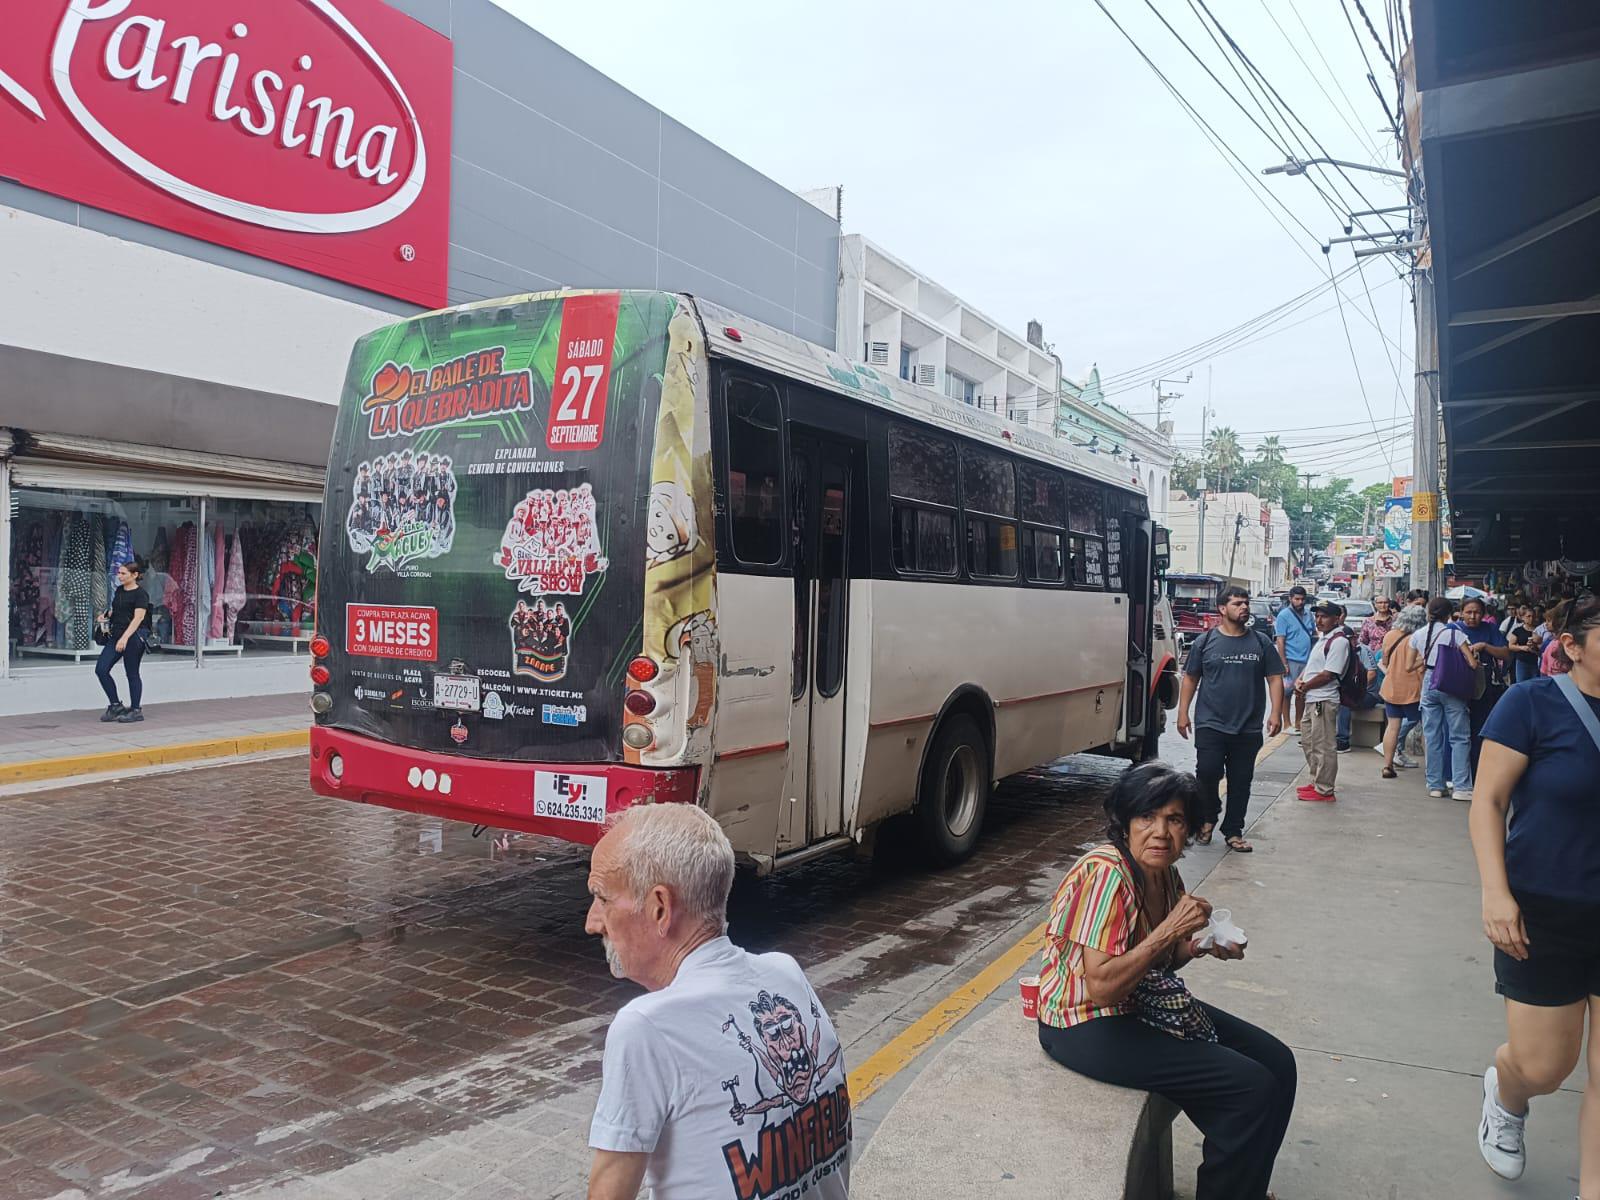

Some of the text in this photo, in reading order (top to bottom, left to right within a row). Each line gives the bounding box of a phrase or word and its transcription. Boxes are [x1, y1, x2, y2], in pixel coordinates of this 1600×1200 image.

[567, 337, 603, 359] SÁBADO
[410, 351, 502, 396] EL BAILE DE
[557, 365, 604, 421] 27
[372, 374, 529, 433] LA QUEBRADITA
[550, 424, 599, 444] SEPTIEMBRE
[494, 447, 537, 460] EXPLANADA
[468, 461, 565, 475] CENTRO DE CONVENCIONES
[540, 575, 581, 592] SHOW
[357, 609, 431, 621] COMPRA EN PLAZA ACAYA
[355, 619, 431, 646] 3 MESES
[353, 644, 367, 652] CON
[368, 645, 395, 655] TARJETAS
[395, 647, 404, 656] DE
[403, 669, 422, 677] PLAZA
[477, 669, 511, 678] ESCOCESA
[516, 687, 583, 699] WWW.XTICKET.MX
[547, 802, 603, 822] 624.235.3343
